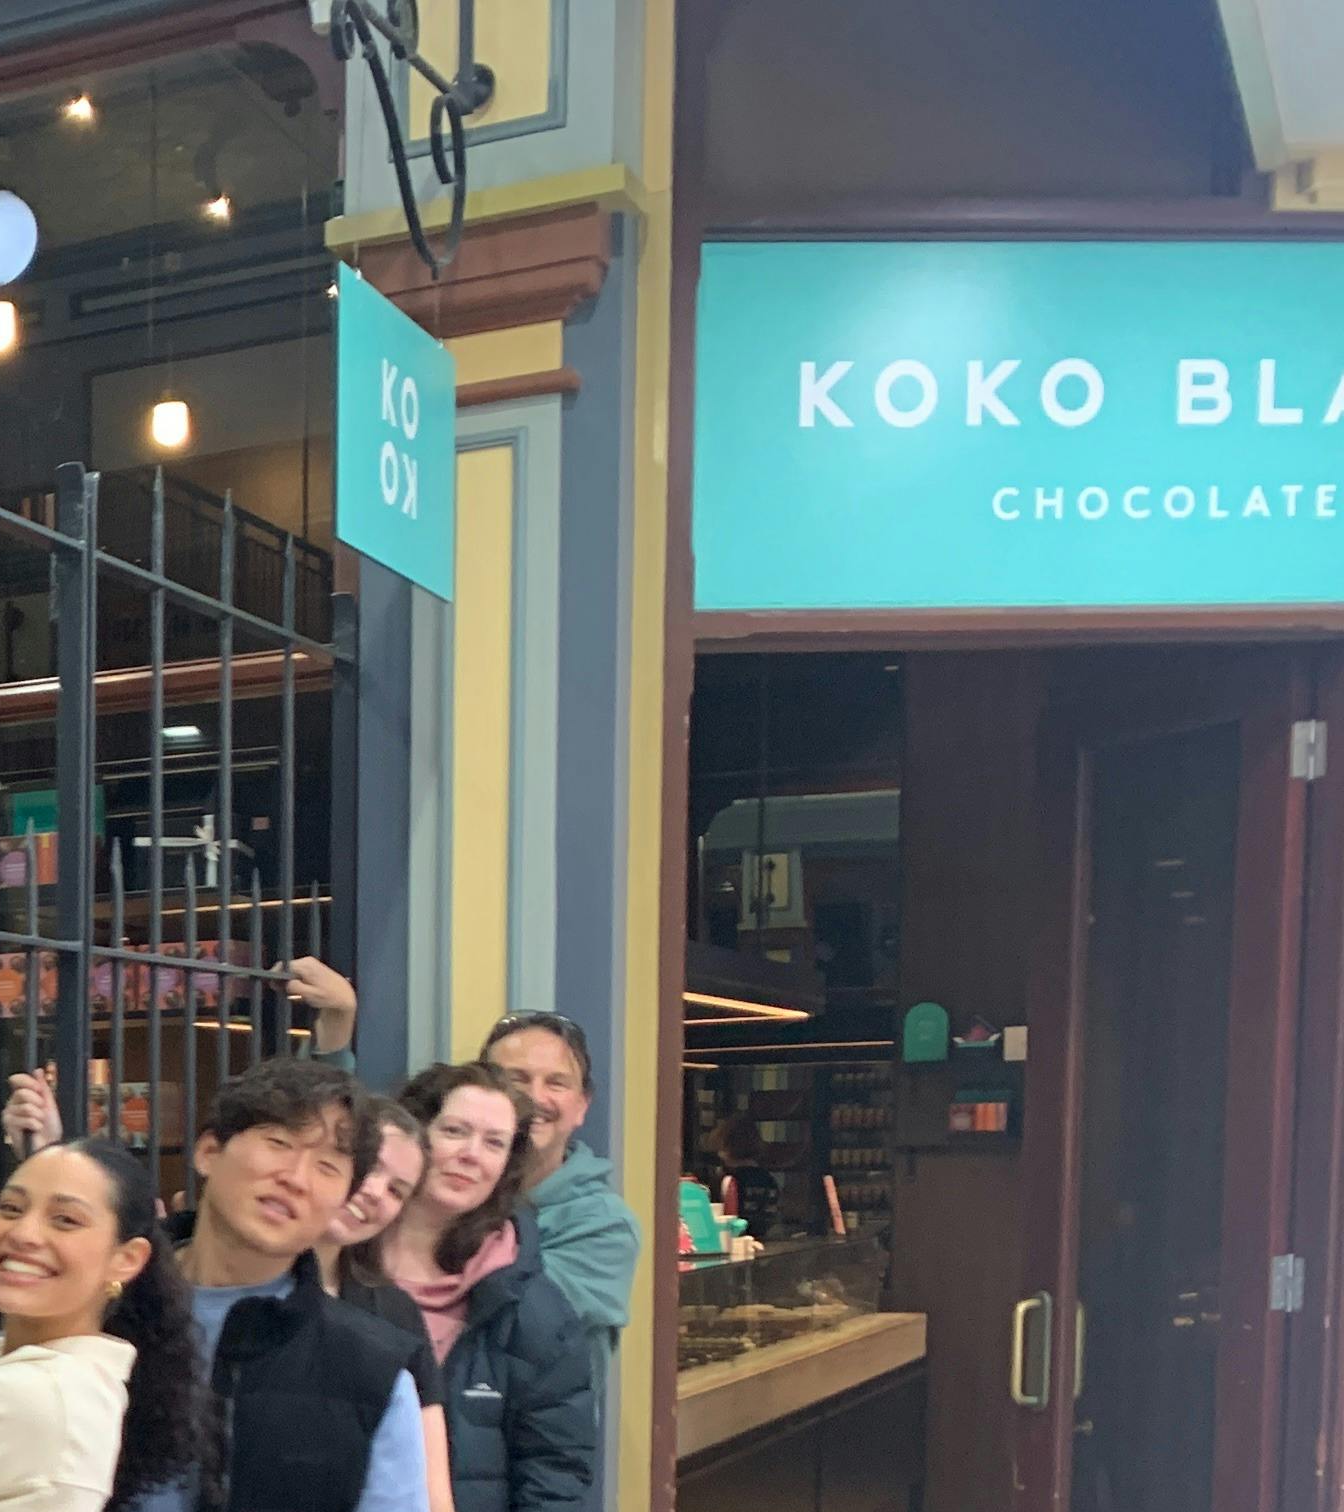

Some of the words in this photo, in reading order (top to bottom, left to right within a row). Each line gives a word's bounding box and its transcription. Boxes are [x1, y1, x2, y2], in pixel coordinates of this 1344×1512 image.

[381, 357, 419, 440] KO
[798, 357, 1105, 429] KOKO
[991, 484, 1337, 521] CHOCOLATE
